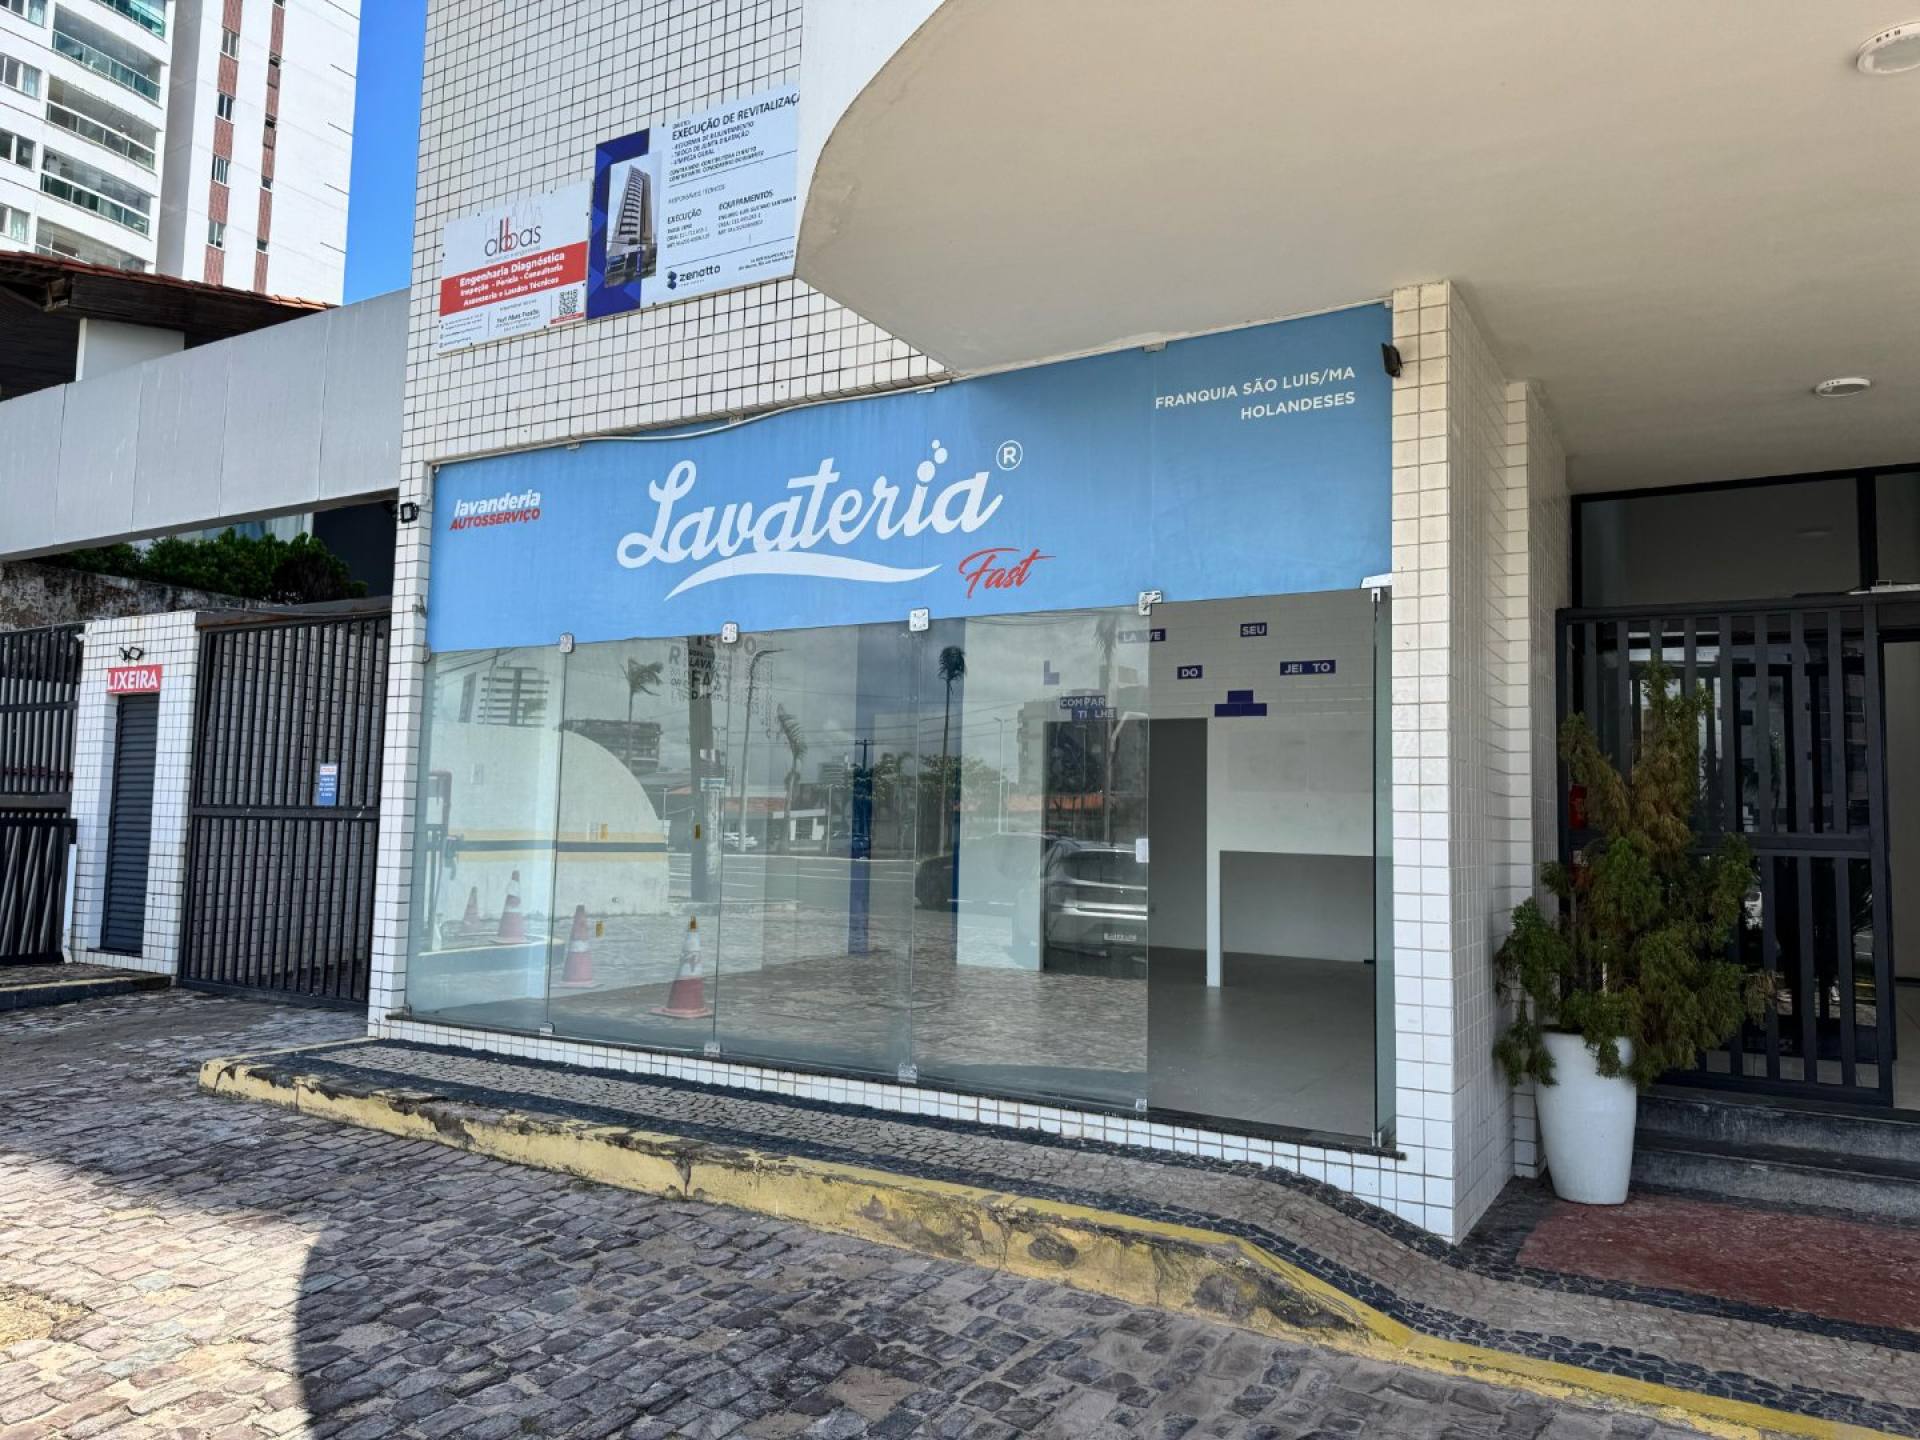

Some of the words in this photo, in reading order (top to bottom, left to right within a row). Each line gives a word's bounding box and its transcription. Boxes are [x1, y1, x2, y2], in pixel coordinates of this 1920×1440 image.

[672, 118, 721, 140] EXECUÇÃO
[723, 113, 735, 125] DE
[667, 208, 702, 224] EXECUÇÃO
[718, 189, 774, 211] EQUIPAMENTOS
[460, 266, 509, 288] Engenharia
[511, 252, 565, 273] Diagnóstica
[679, 264, 721, 282] zenatto
[1155, 384, 1238, 409] FRANQUIA
[1242, 377, 1278, 395] SÃO
[1283, 366, 1355, 389] LUIS/MA
[1241, 391, 1356, 420] HOLANDESES
[454, 489, 541, 517] lavanderia
[617, 450, 1003, 569] Lavateria
[449, 508, 541, 531] AUTOSSERVIÇO
[958, 547, 1056, 599] Fast
[1242, 625, 1266, 636] SEU
[107, 669, 158, 691] LIXEIRA
[1181, 668, 1198, 678] DO
